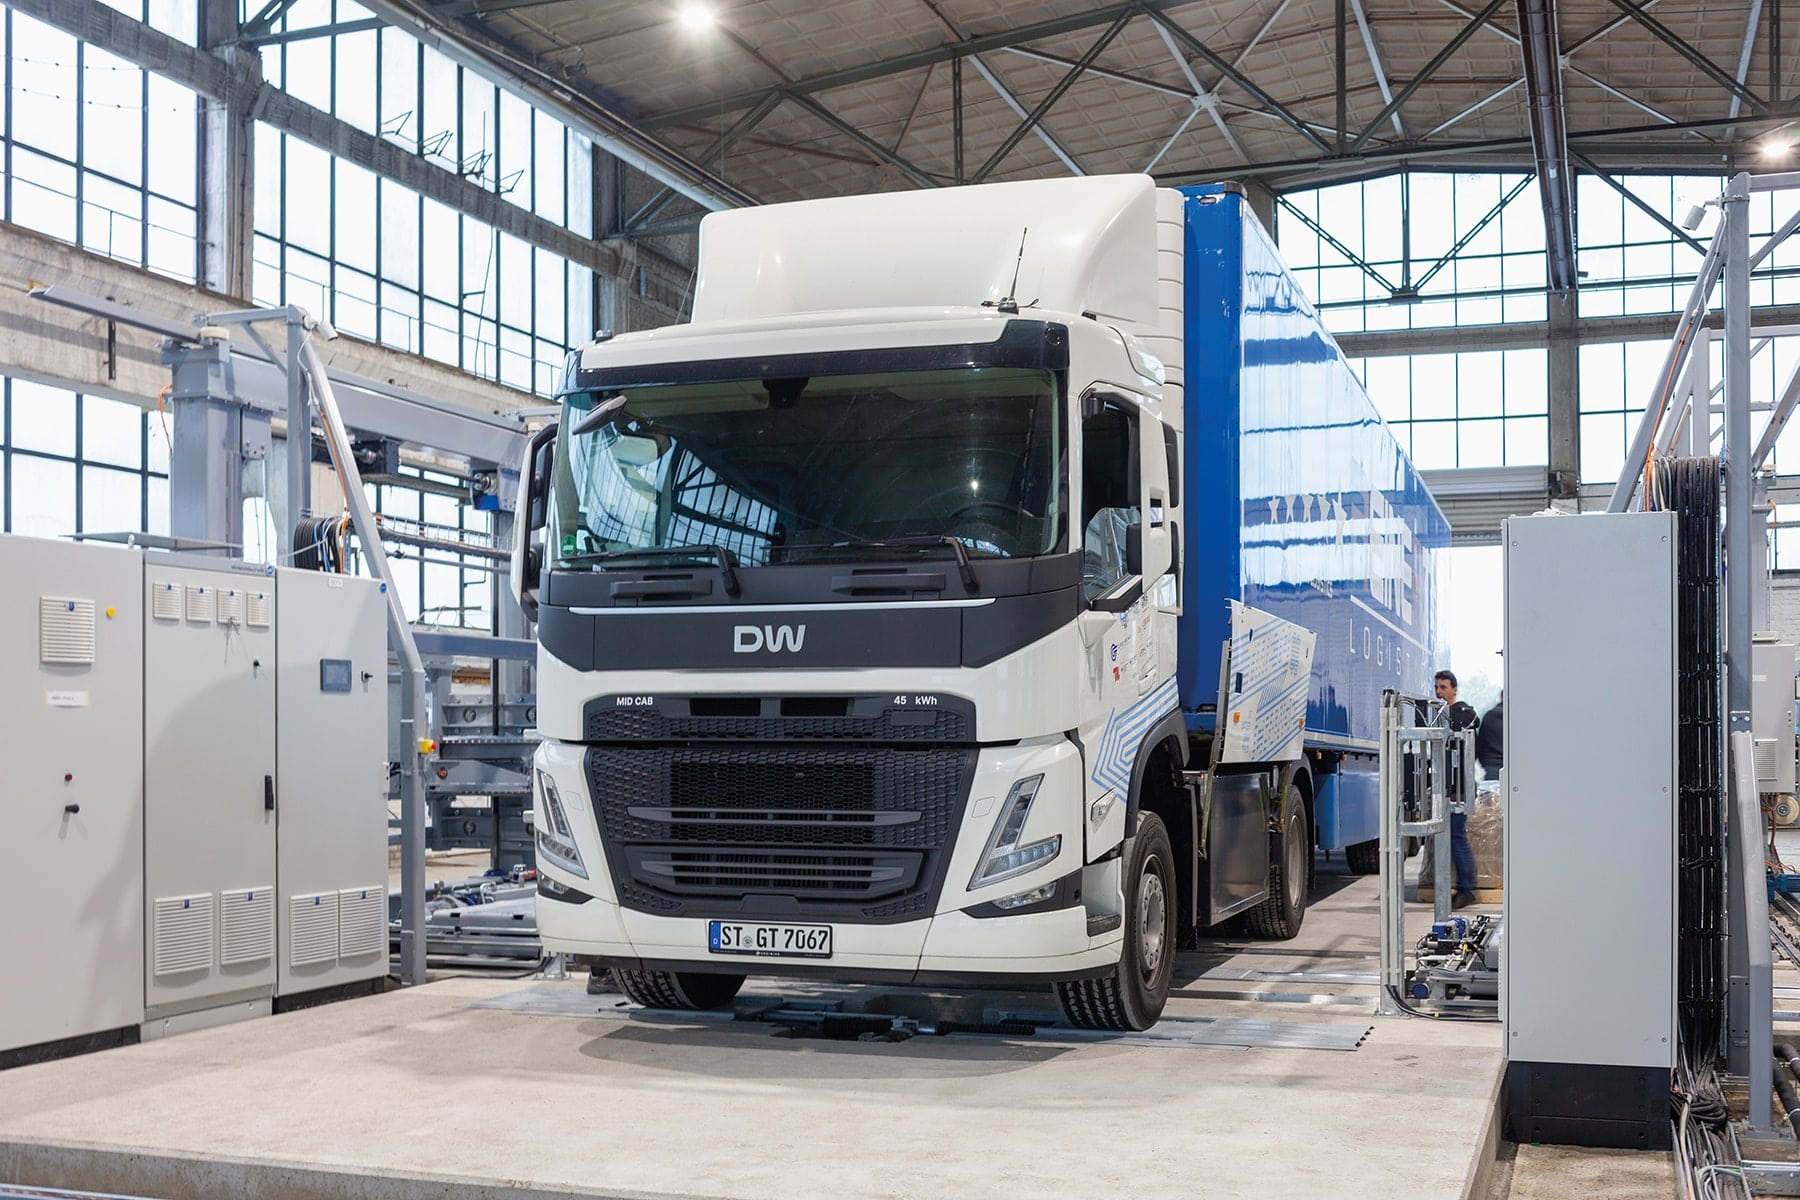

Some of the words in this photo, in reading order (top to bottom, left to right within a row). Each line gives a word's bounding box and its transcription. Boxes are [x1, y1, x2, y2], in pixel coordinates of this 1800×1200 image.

[734, 624, 806, 653] DW
[616, 696, 633, 706] MID
[634, 696, 653, 706] CAB
[893, 695, 907, 705] 45
[915, 695, 938, 705] kWh
[722, 926, 743, 946] ST
[756, 927, 778, 948] GT
[784, 929, 828, 950] 7067
